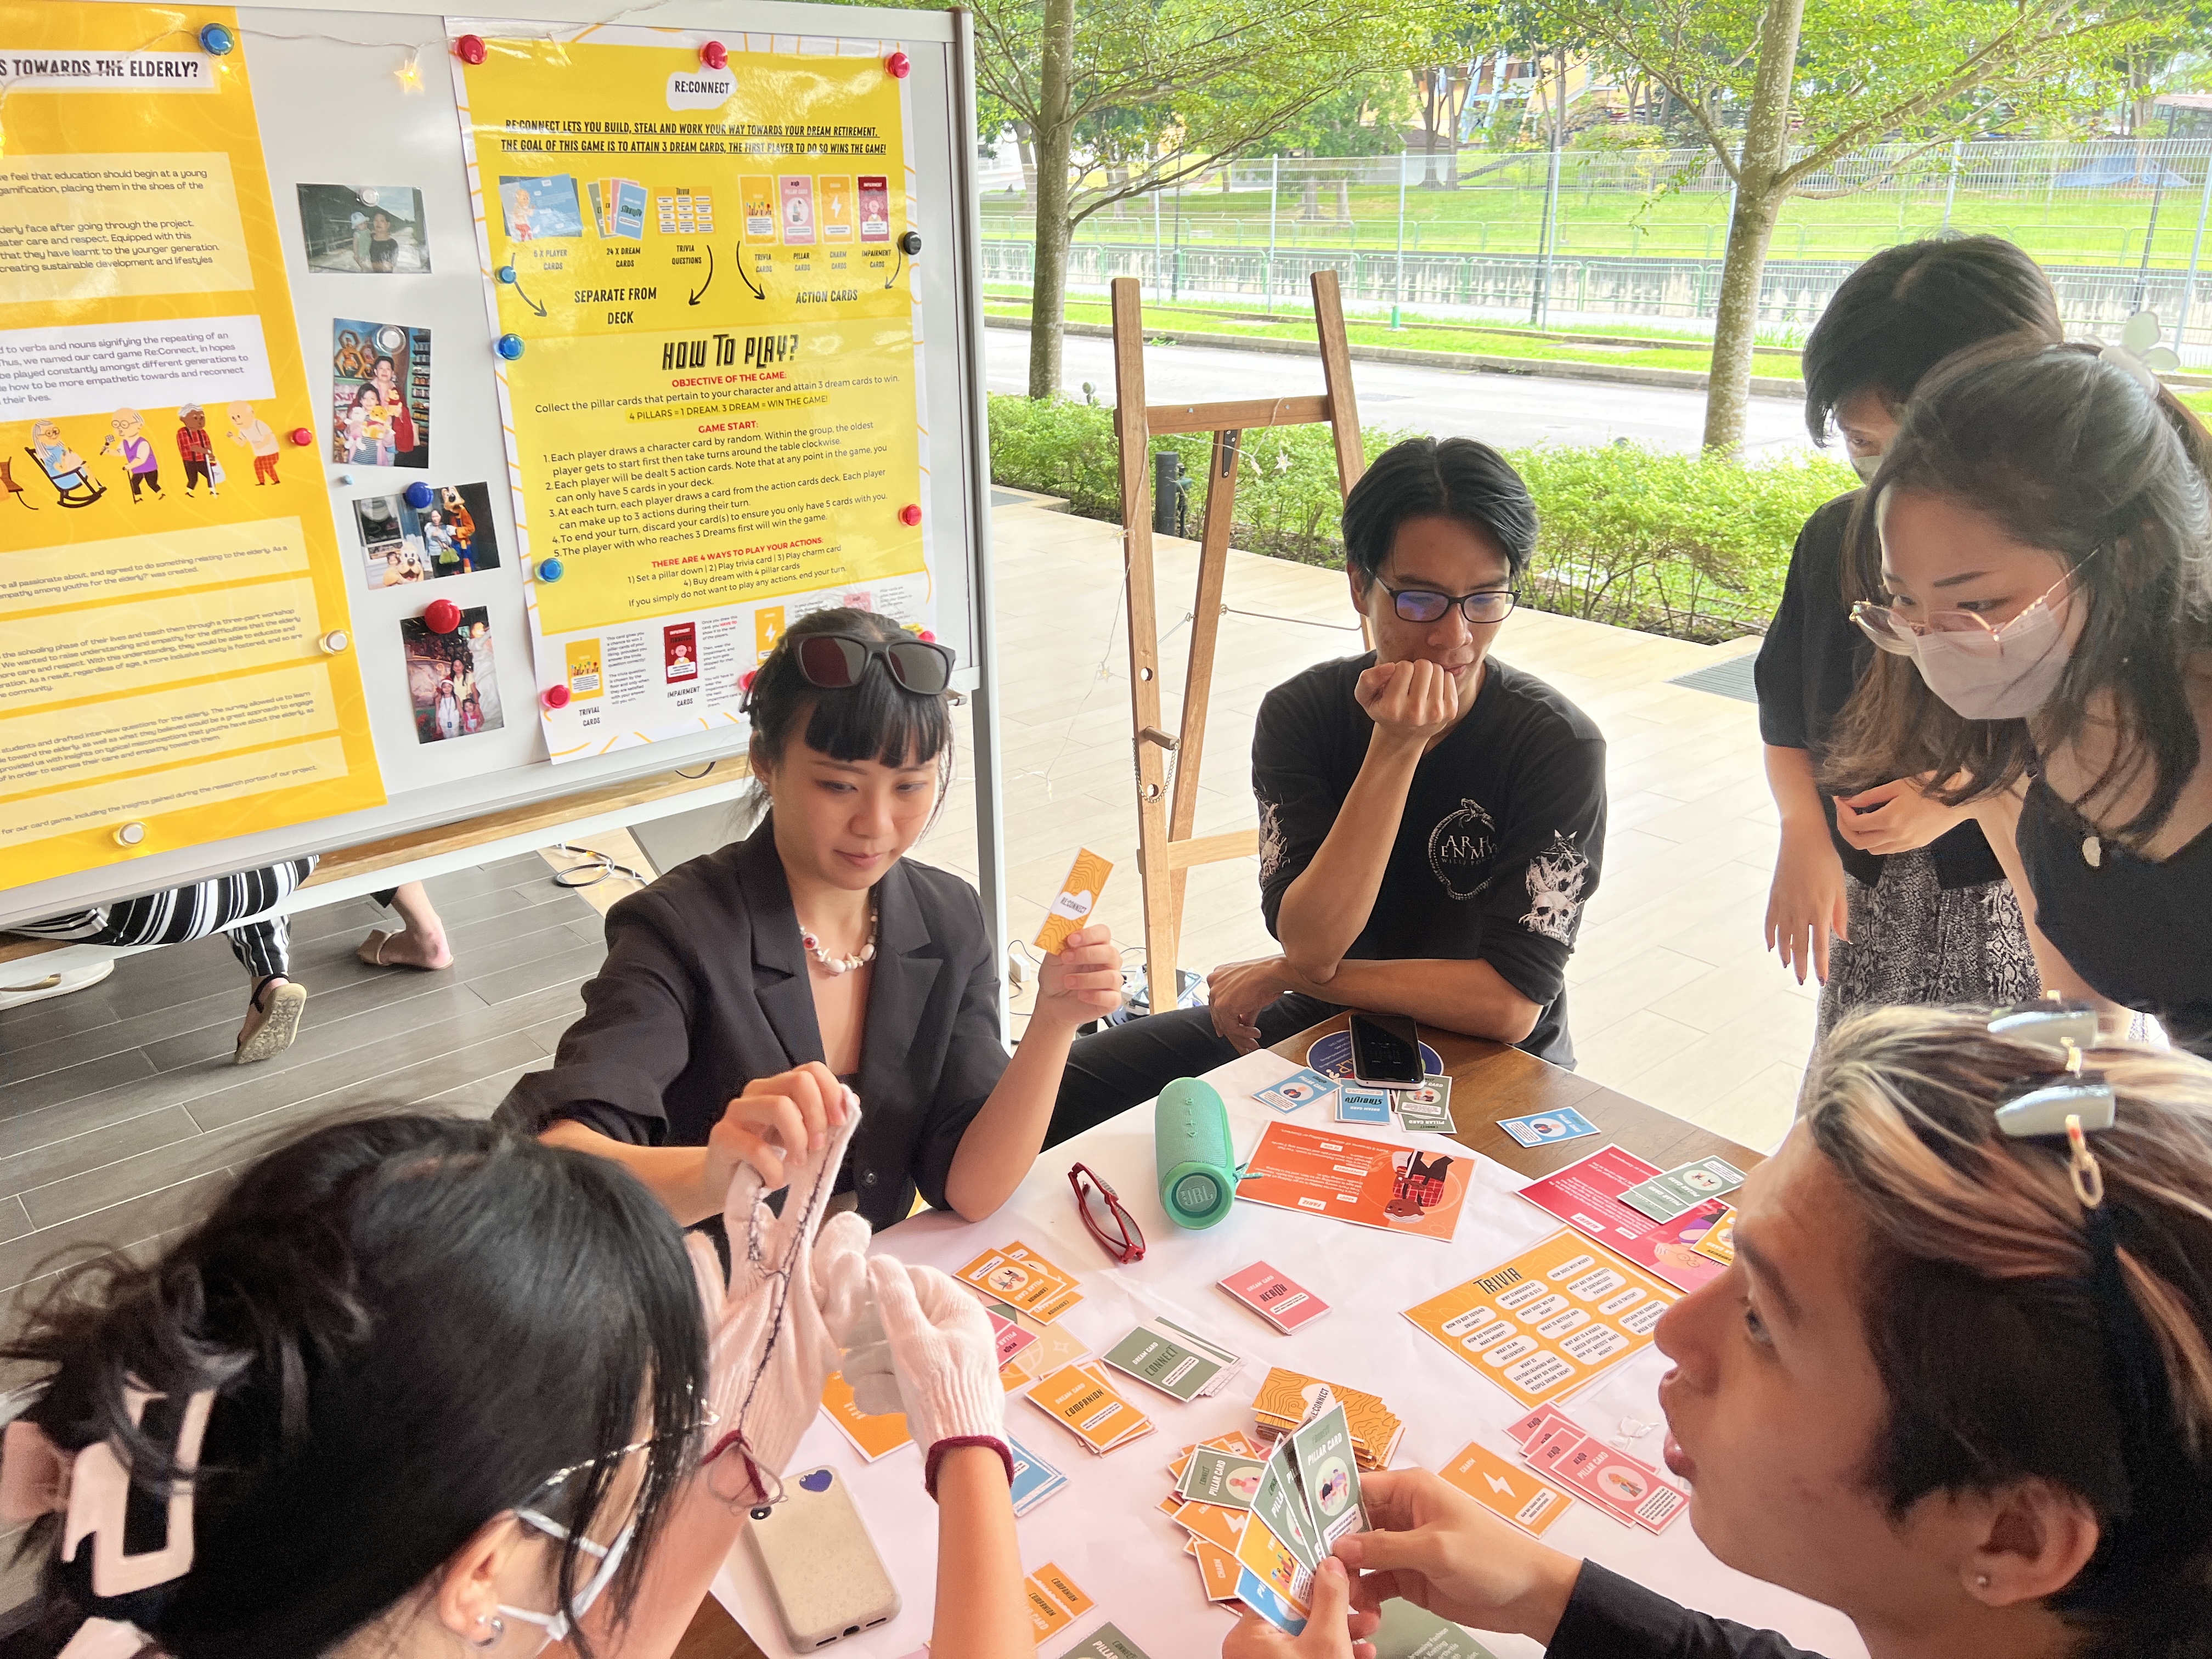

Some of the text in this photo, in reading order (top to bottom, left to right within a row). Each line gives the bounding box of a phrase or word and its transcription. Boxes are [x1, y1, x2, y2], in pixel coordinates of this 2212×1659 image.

[13, 59, 199, 77] TOWARDS THE ELDERLY?
[675, 81, 730, 94] RE:CONNECT
[563, 121, 582, 132] LETS
[584, 121, 601, 132] YOU
[605, 122, 631, 134] BUILD,
[634, 122, 658, 134] STEAL
[659, 123, 676, 133] AND
[679, 123, 703, 134] WORK
[705, 123, 726, 134] YOUR
[729, 125, 746, 136] WAY
[747, 125, 783, 137] TOWARDS
[785, 125, 805, 137] YOUR
[806, 126, 831, 138] DREAM
[833, 126, 878, 138] RETIREMENT.
[501, 139, 886, 155] THE GOAL OF THIS GAME IS TO ATTAIN 3 DREAM CARDS, THE FIRST PLAYER TO DO SO WINS THE GAME!
[0, 251, 22, 260] that
[22, 250, 46, 260] they
[46, 249, 70, 257] have
[71, 248, 100, 256] learnt
[114, 246, 130, 255] the
[132, 246, 168, 256] younger
[170, 244, 220, 254] generation.
[539, 250, 544, 258] X
[545, 249, 567, 257] PLAYER
[621, 247, 641, 255] DREAM
[544, 262, 563, 270] CARDS
[616, 259, 634, 268] CARDS
[672, 257, 702, 265] QUESTIONS
[574, 287, 657, 303] SEPARATE FROM
[795, 290, 857, 304] ACTION CARDS
[607, 311, 634, 325] DECK
[19, 343, 47, 353] verbs
[49, 341, 67, 351] and
[98, 337, 142, 348] signifying
[143, 336, 159, 344] the
[160, 334, 204, 344] repeating
[205, 332, 215, 340] of
[662, 334, 798, 370] HOW TO PLAY?
[672, 371, 787, 387] OBJECTIVE OF THE GAME:
[698, 420, 758, 433] GAME START:
[556, 495, 574, 503] can
[575, 490, 596, 501] only
[598, 489, 621, 498] have
[623, 487, 629, 495] 5
[630, 484, 656, 494] cards
[668, 481, 689, 492] your
[690, 477, 714, 487] deck.
[651, 558, 680, 568] THERE
[681, 555, 699, 564] ARE
[707, 550, 732, 560] WAYS
[732, 549, 744, 557] TO
[745, 545, 765, 555] PLAY
[766, 542, 788, 551] YOUR
[789, 537, 823, 548] ACTIONS:
[667, 686, 700, 698] IMPAIRMENT
[676, 698, 693, 707] CARDS
[579, 706, 600, 716] TRIVIAL
[583, 717, 601, 727] CARDS
[1181, 1186, 1214, 1205] JBL
[1473, 1267, 1522, 1294] TRIVIA
[1132, 1342, 1159, 1365] DREAM CARD
[1144, 1345, 1178, 1376] CONNECT
[1055, 1383, 1086, 1404] DREAM CARD
[1064, 1389, 1104, 1417] COMPANION
[1307, 1433, 1343, 1465] PILLAR CARD
[1459, 1458, 1476, 1473] CHARM
[1577, 1451, 1609, 1479] PILLAR CARD
[1209, 1460, 1226, 1496] PILLAR CARD
